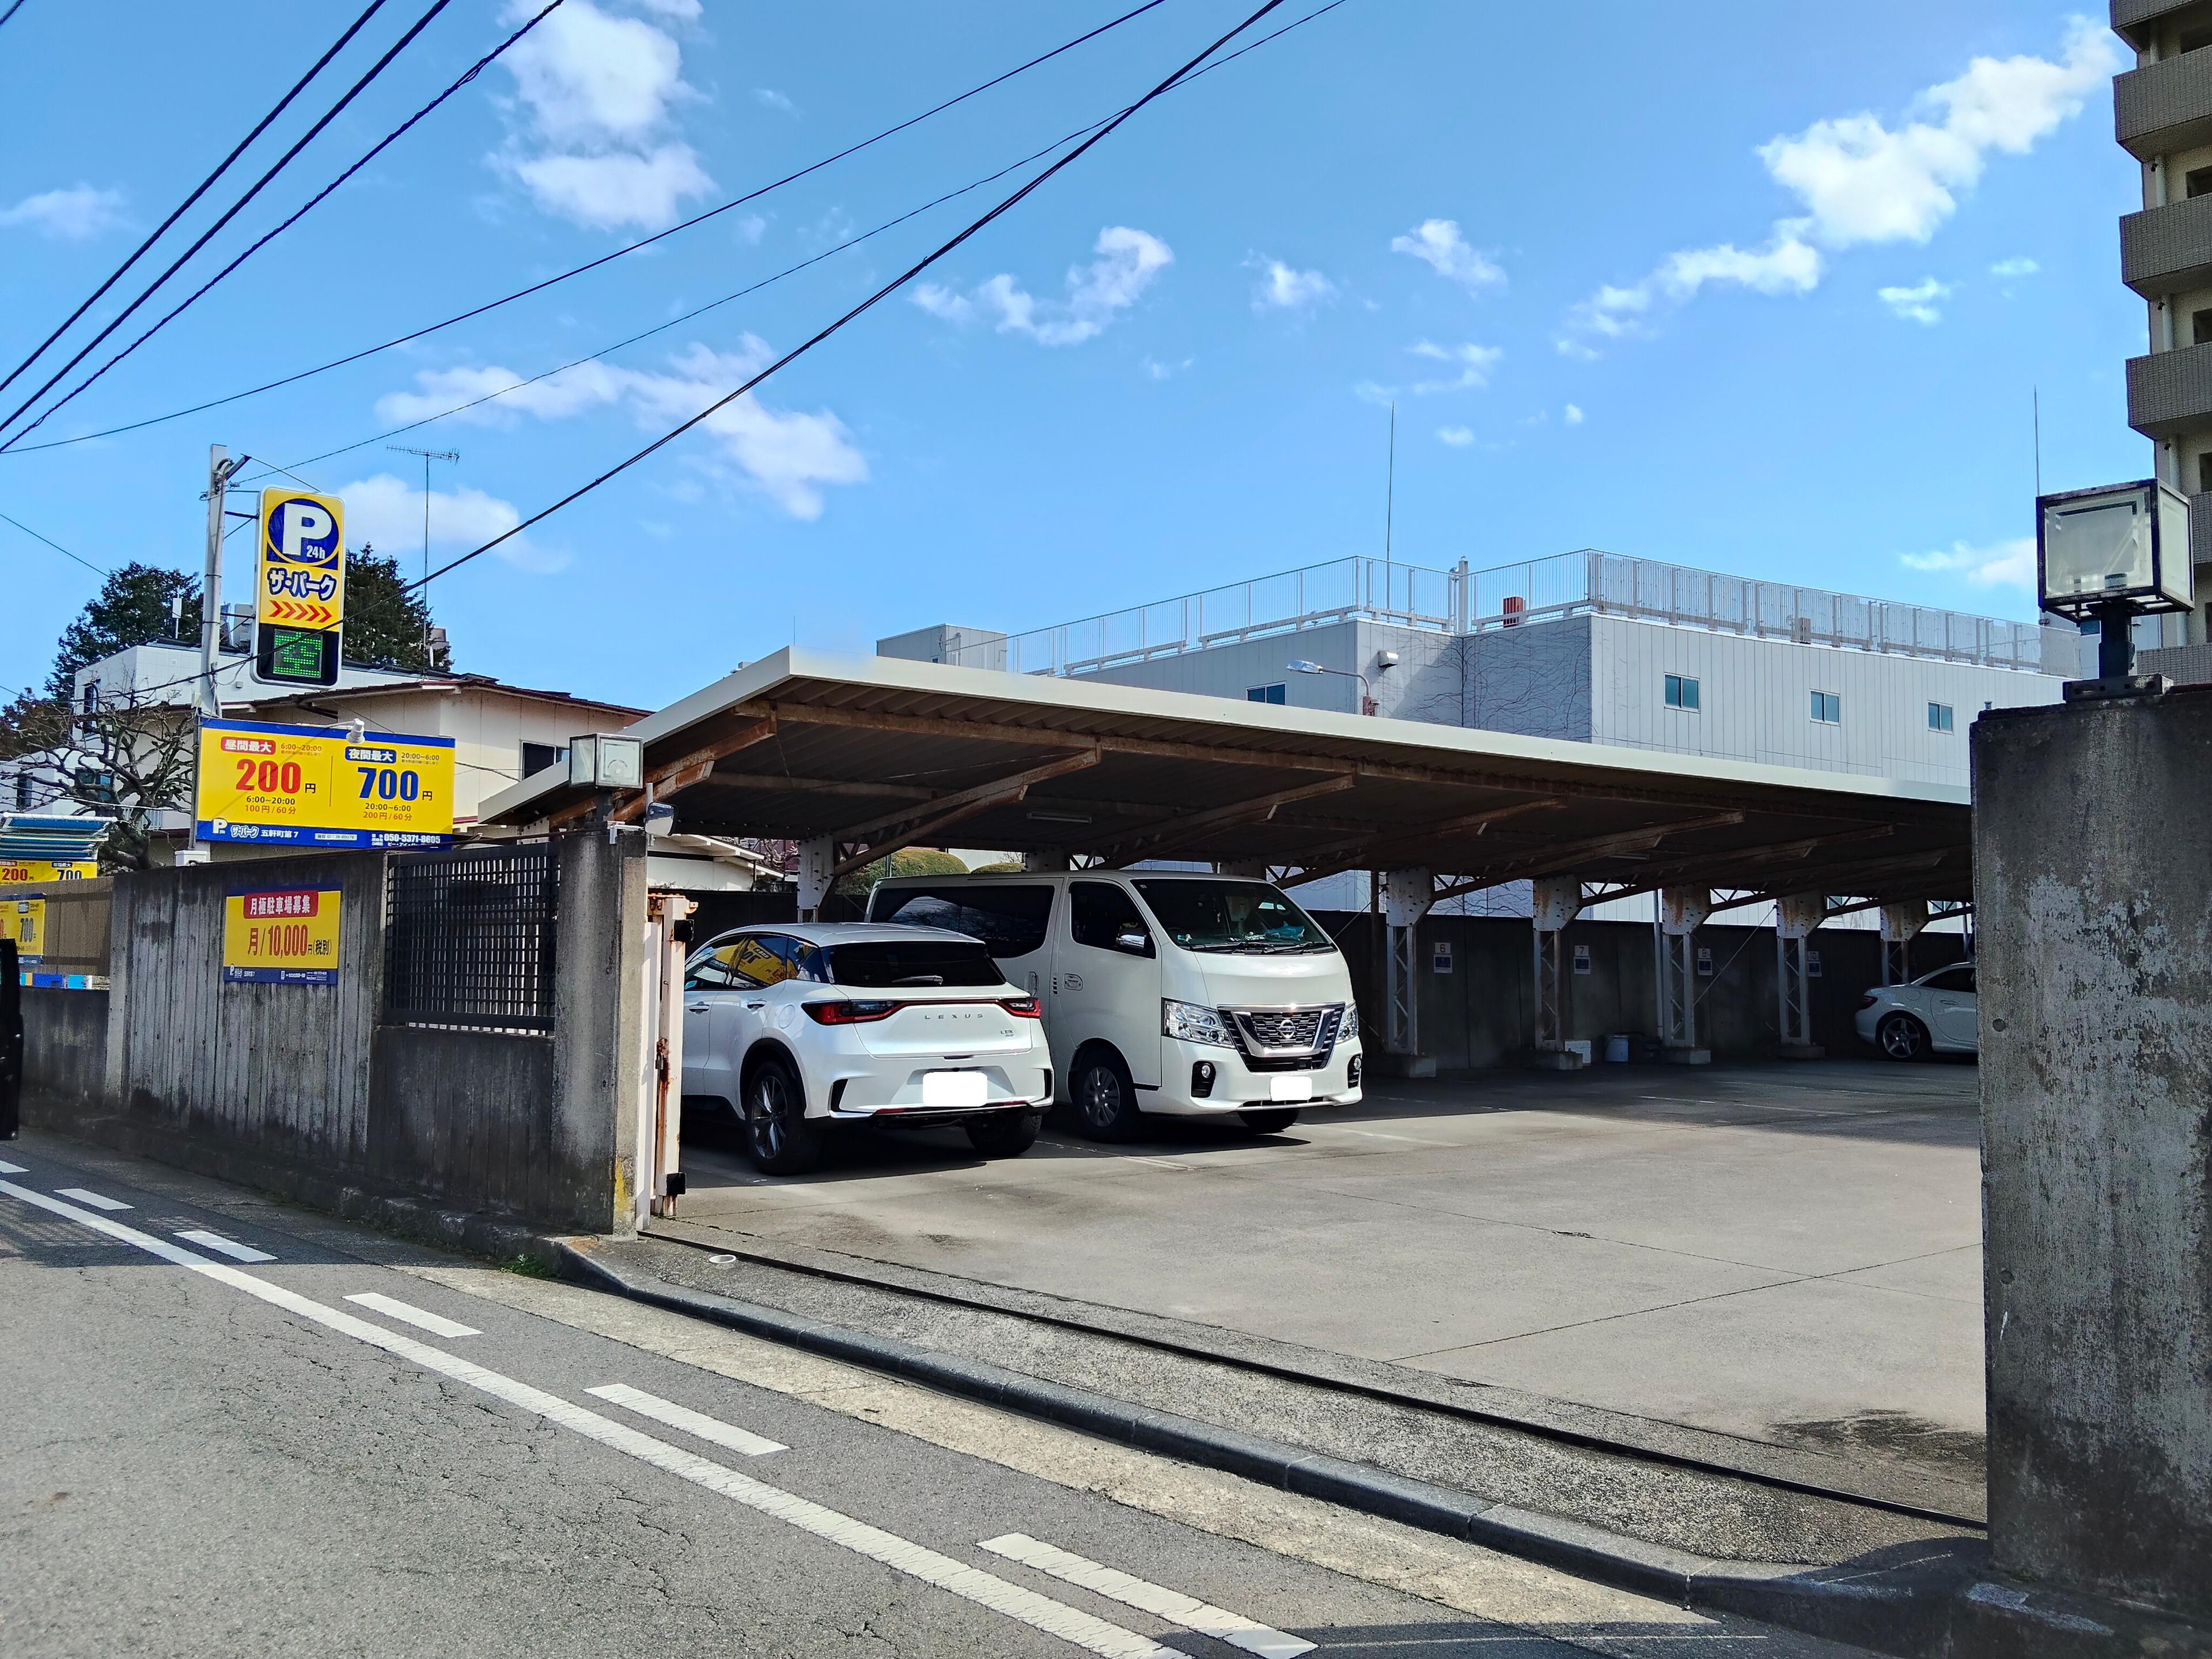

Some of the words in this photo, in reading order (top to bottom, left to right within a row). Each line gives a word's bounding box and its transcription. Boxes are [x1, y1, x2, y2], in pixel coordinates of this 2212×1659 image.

[283, 503, 332, 556] P
[306, 545, 325, 559] 24h
[268, 569, 336, 600] ザ・パーク
[225, 739, 272, 753] 昼間最大
[349, 748, 393, 762] 夜間最大
[384, 833, 441, 843] 050-5371-8605
[1440, 944, 1446, 953] 6
[1579, 946, 1584, 955] 7
